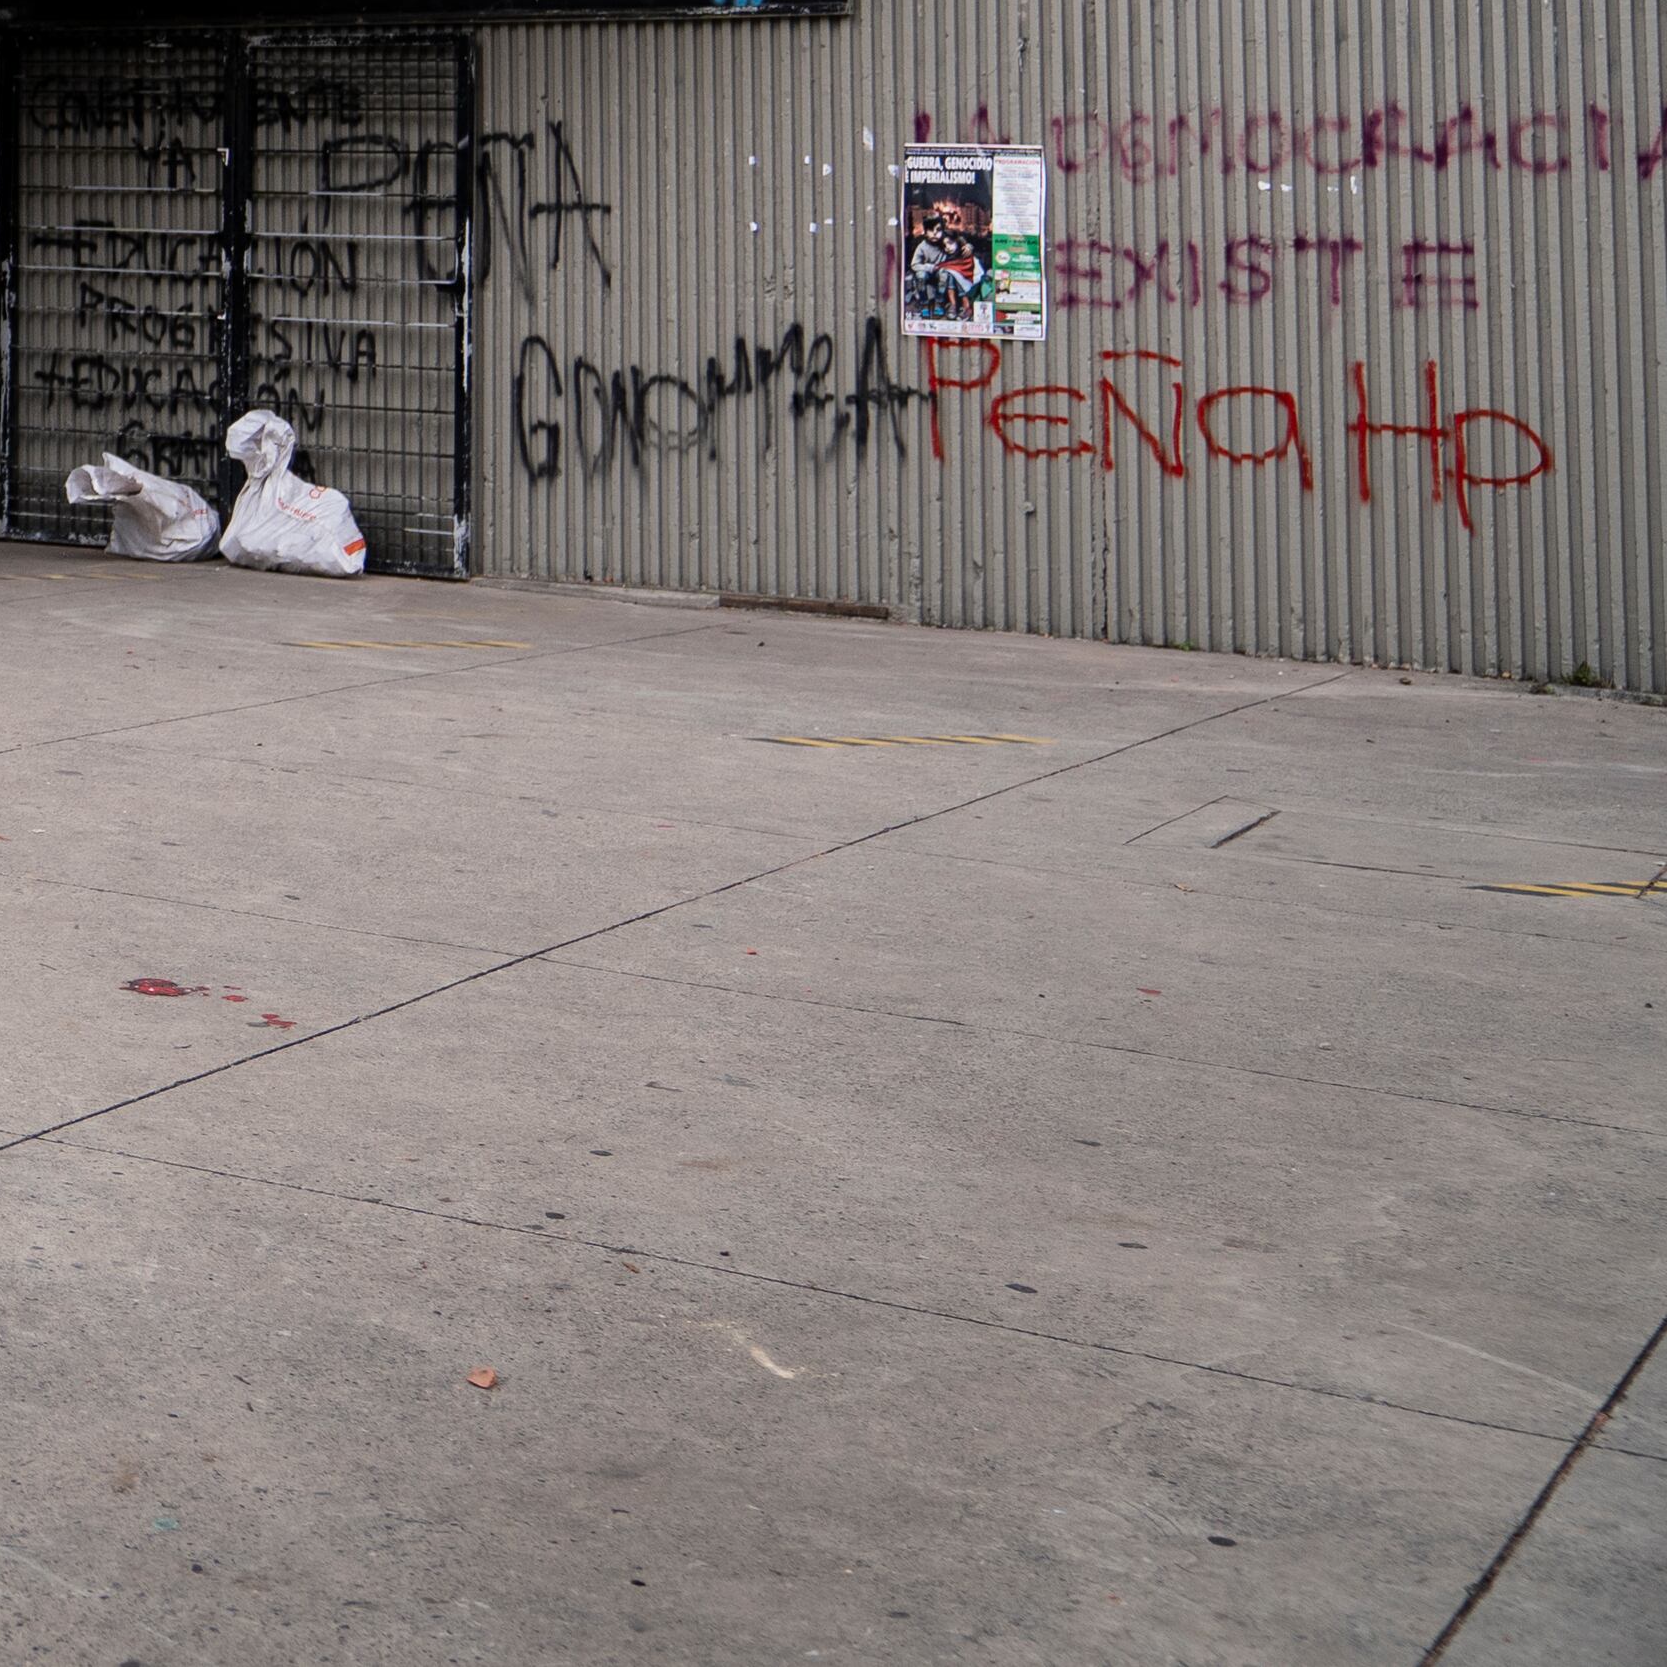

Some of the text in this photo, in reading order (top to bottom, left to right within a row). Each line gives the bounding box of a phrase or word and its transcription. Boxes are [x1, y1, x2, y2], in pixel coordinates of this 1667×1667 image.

[945, 156, 993, 172] GENOCIDIO
[910, 170, 976, 184] IMPERIALISMO!
[1054, 232, 1479, 312] EXISTE
